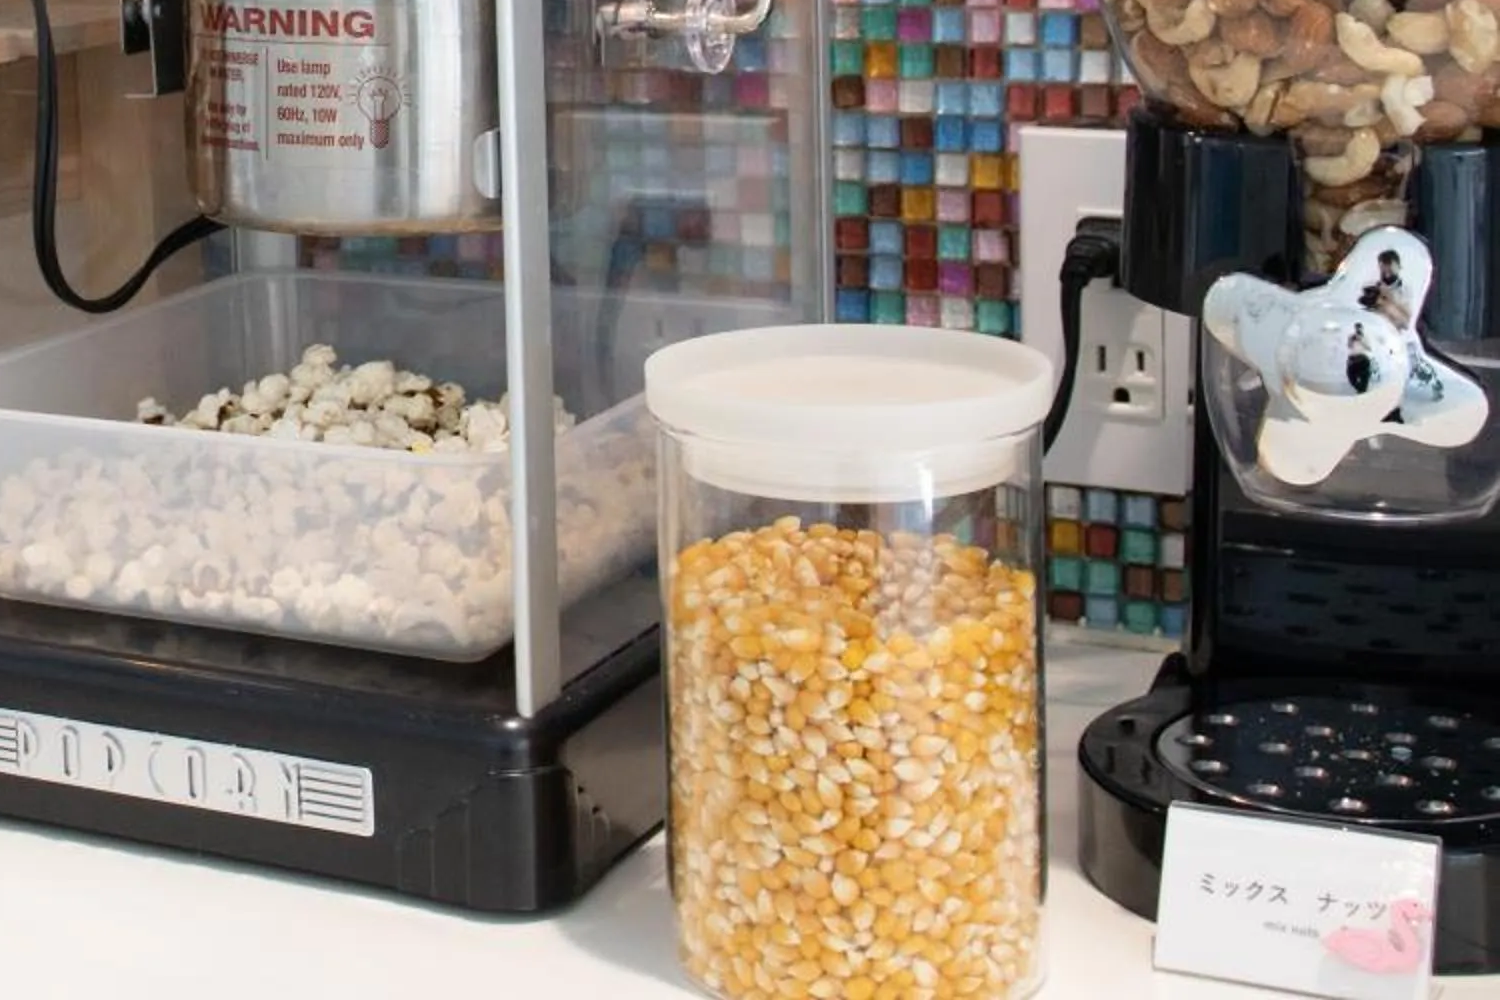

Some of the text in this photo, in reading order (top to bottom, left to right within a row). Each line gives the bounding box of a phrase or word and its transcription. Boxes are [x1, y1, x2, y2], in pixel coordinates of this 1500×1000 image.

[200, 5, 376, 39] WARNING
[277, 58, 297, 73] Use
[301, 59, 331, 77] lamp
[277, 84, 306, 98] rated
[277, 106, 338, 123] 60Hz, 10W
[277, 133, 364, 150] maximum only
[1200, 872, 1388, 921] ミックス ナッツ
